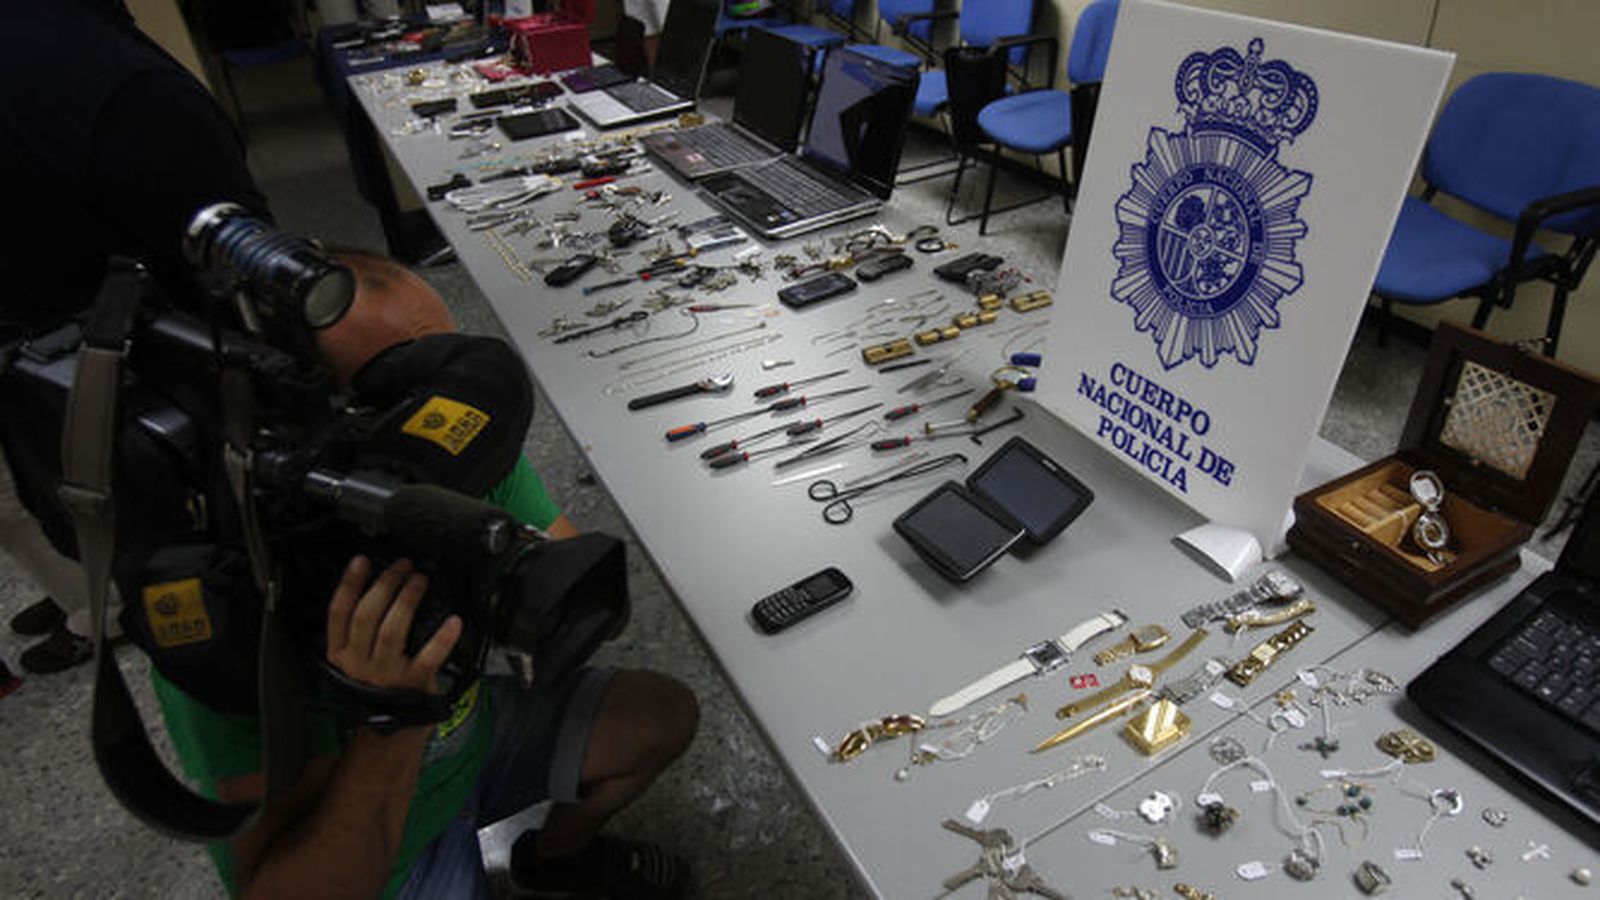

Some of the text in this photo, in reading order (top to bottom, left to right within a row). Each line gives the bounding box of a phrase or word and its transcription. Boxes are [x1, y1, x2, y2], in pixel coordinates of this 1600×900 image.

[1077, 372, 1236, 486] NACIONAL DE
[1110, 362, 1211, 436] CUERPO
[1097, 414, 1188, 493] POLICIA
